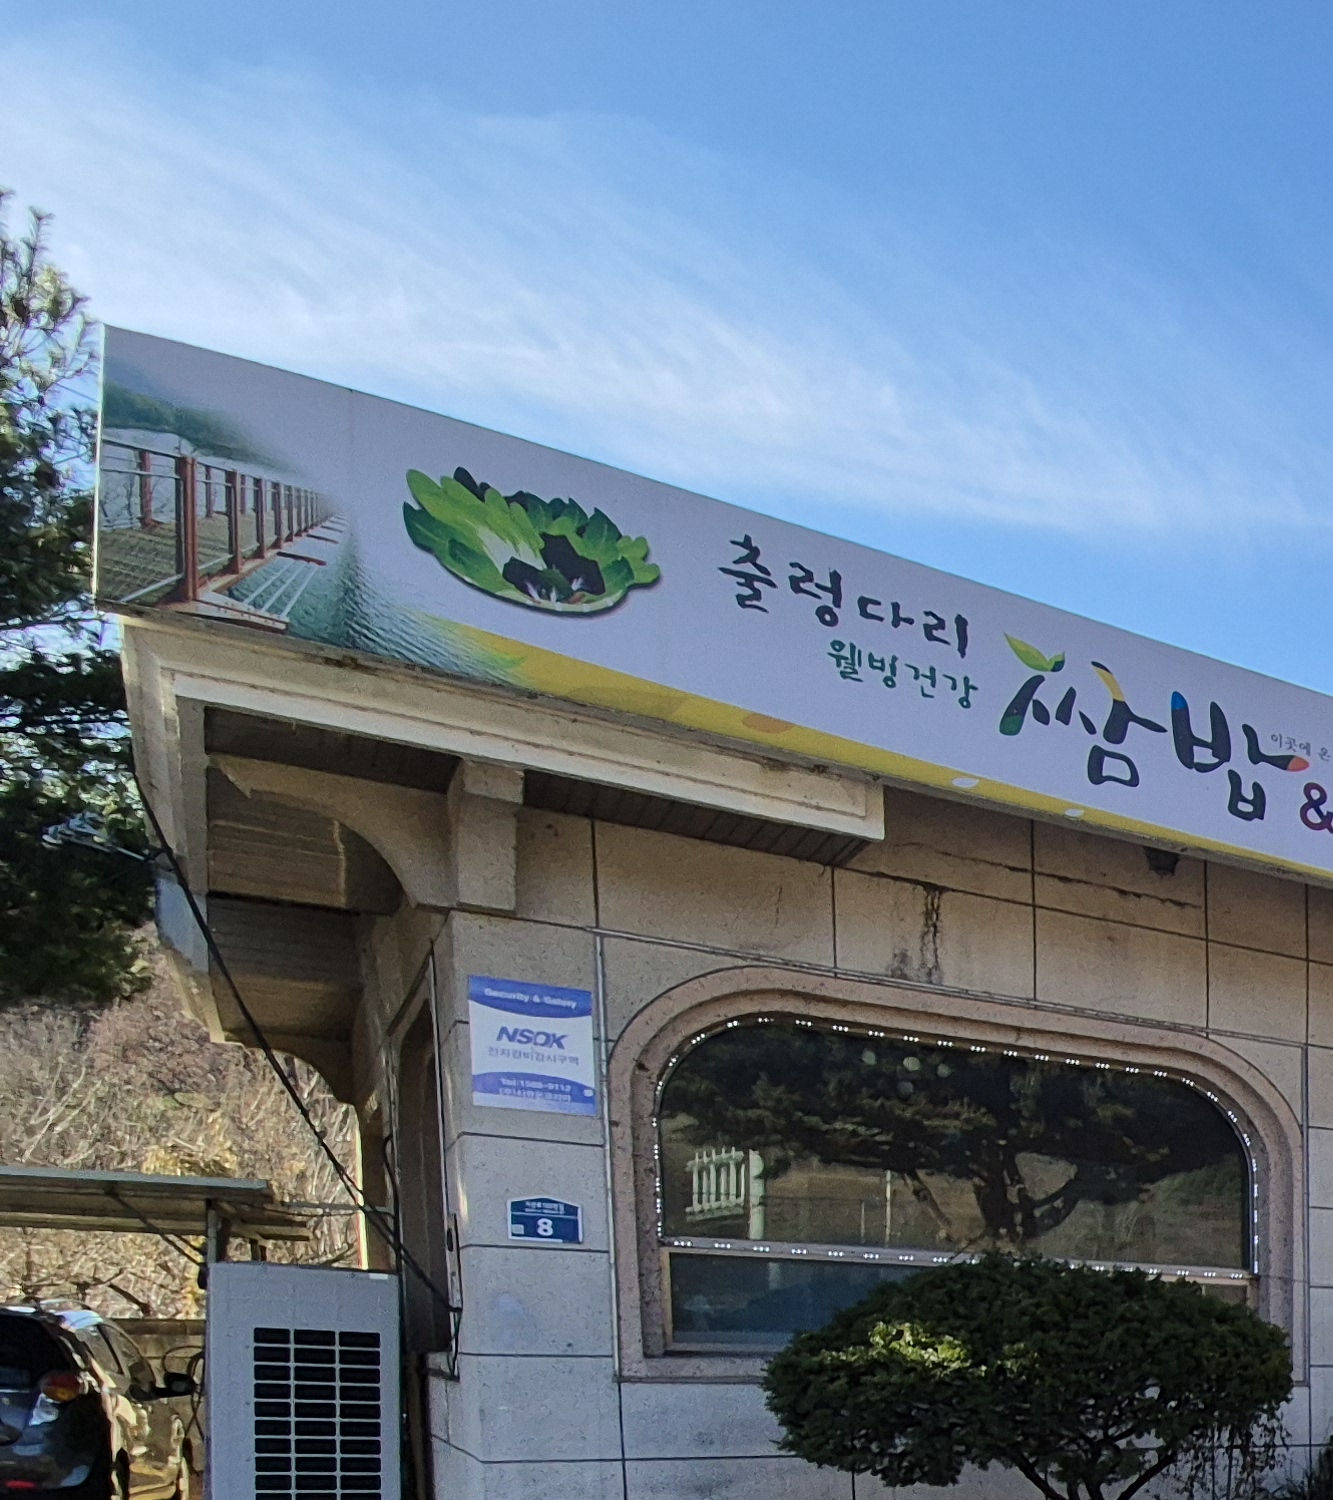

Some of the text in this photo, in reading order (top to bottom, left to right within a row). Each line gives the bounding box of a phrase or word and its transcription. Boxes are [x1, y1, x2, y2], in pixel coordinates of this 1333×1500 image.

[718, 534, 968, 659] 출렁다리
[827, 640, 978, 709] 웰빙건강
[999, 658, 1310, 822] 쌈밥
[1270, 733, 1311, 757] 이곳에
[496, 1026, 570, 1050] NSOK
[537, 1218, 553, 1237] 8
